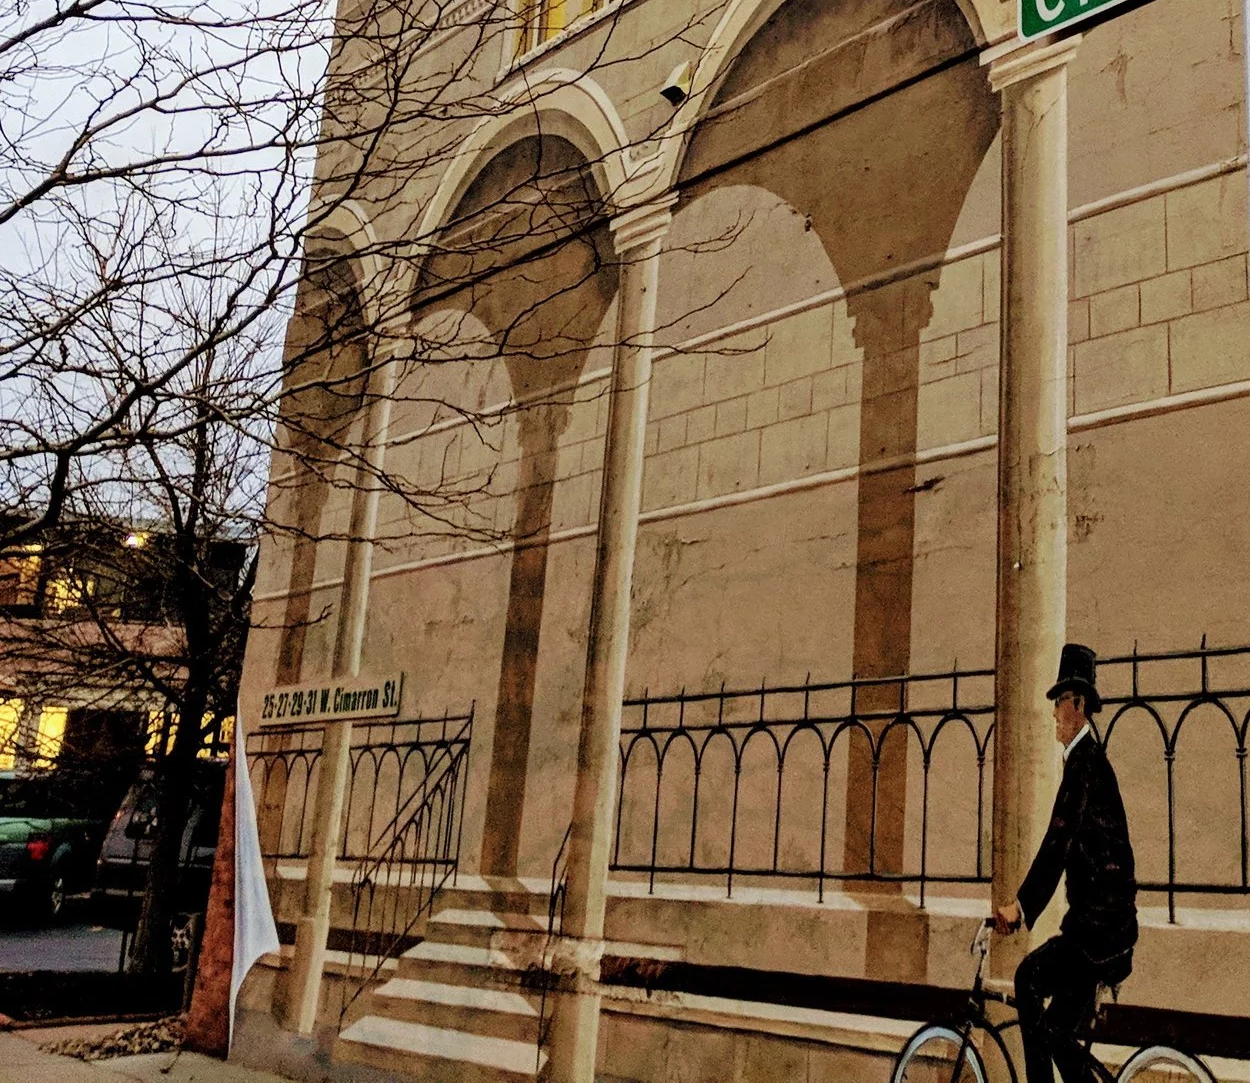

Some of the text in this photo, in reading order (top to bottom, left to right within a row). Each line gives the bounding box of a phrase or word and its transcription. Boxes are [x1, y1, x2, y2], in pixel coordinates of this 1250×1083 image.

[320, 687, 331, 713] W.
[333, 687, 380, 714] Cimarron
[382, 680, 398, 709] St.
